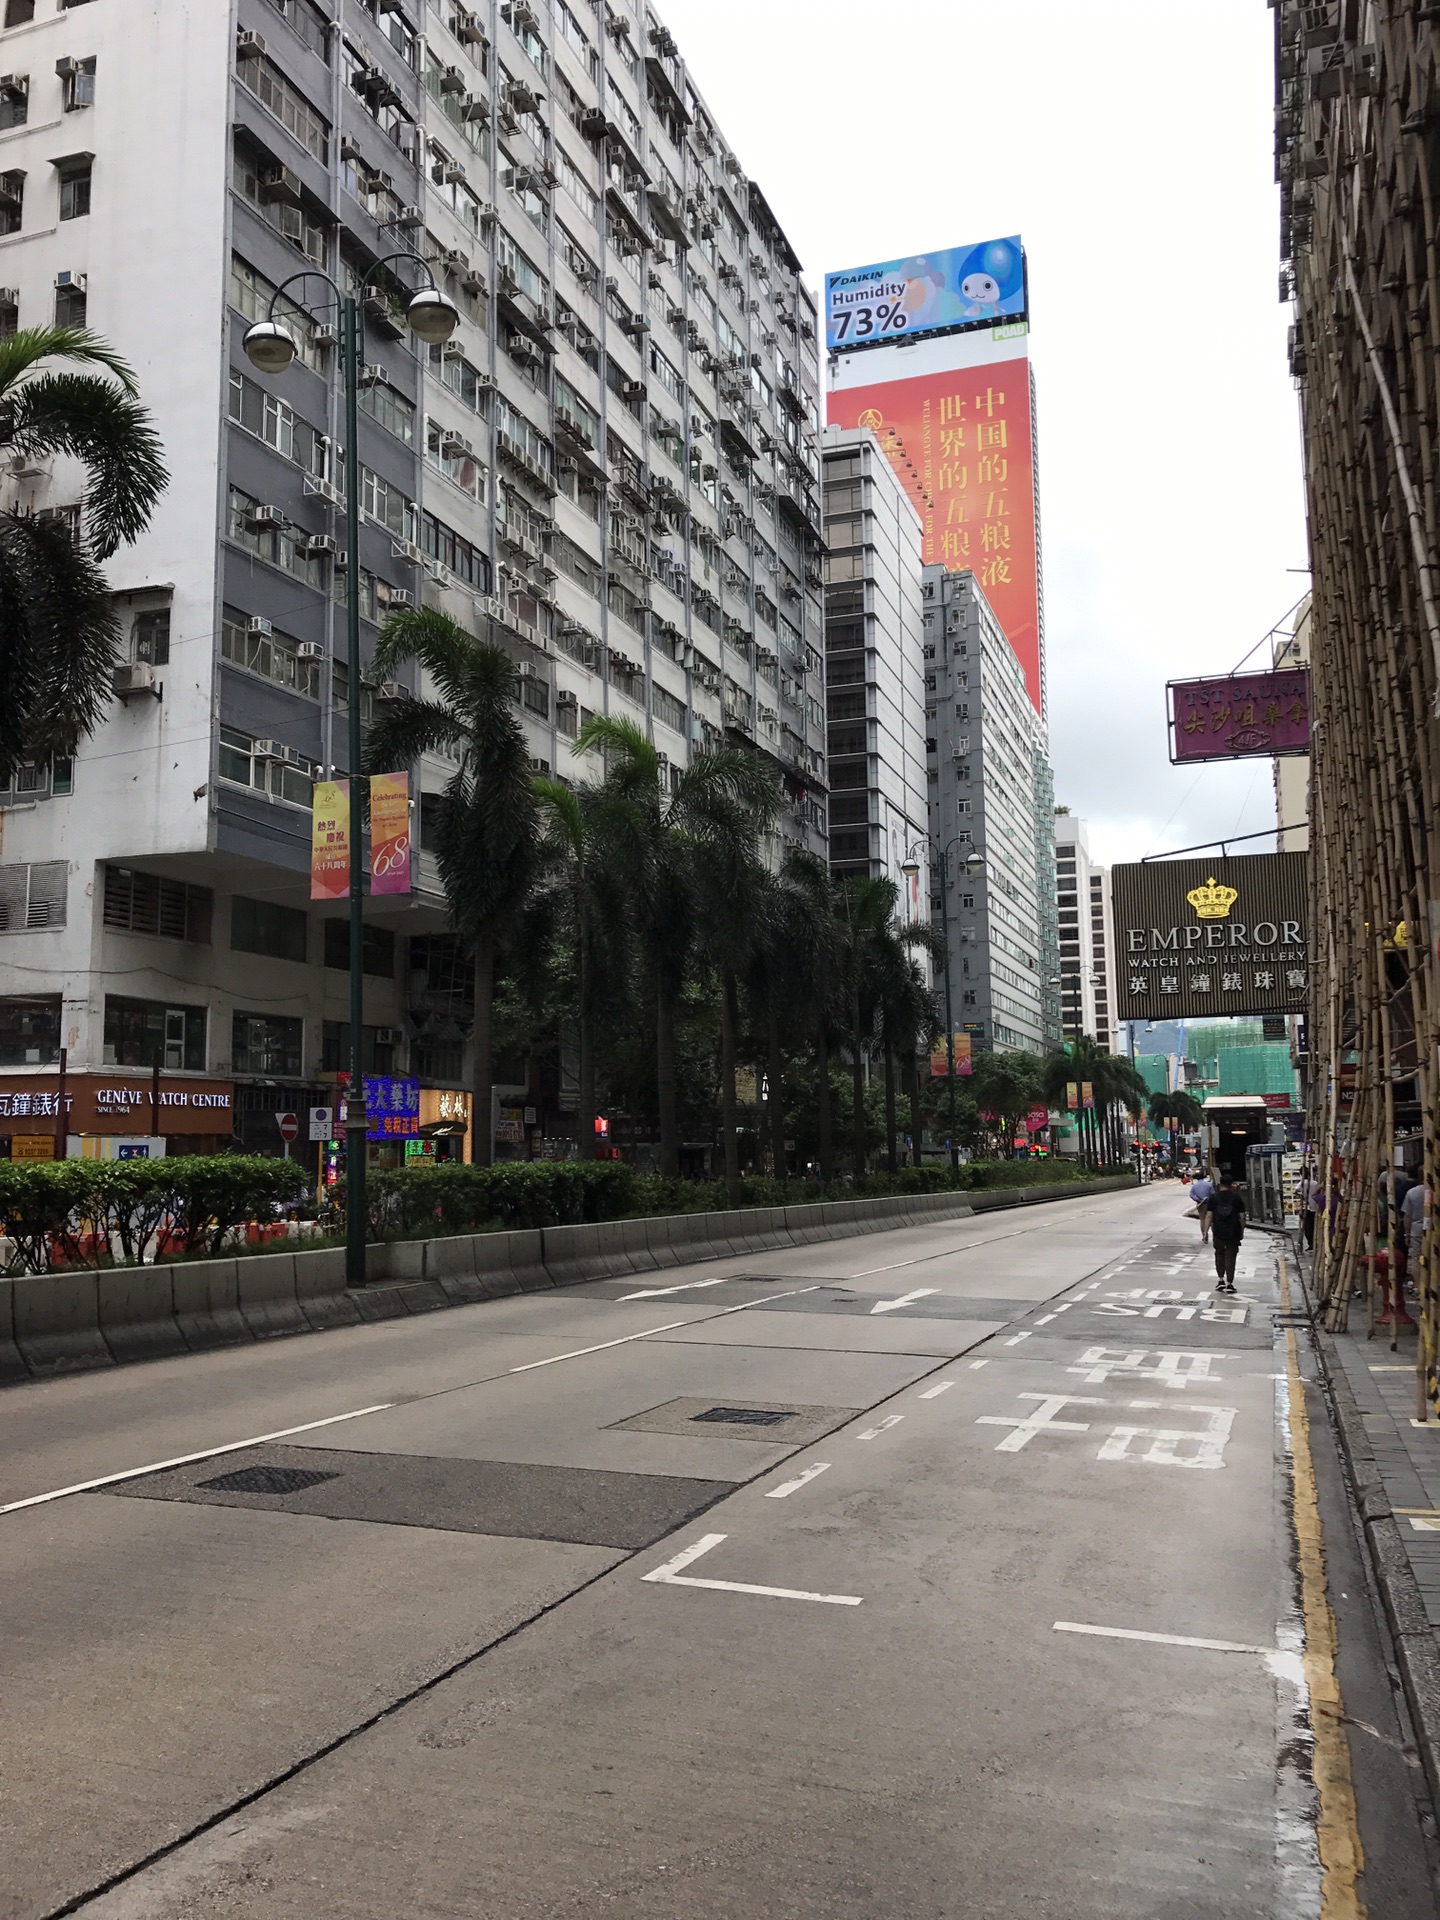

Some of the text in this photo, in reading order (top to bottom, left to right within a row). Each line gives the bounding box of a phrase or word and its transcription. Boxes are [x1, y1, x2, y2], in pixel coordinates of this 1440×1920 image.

[841, 271, 883, 285] DAIKIN
[833, 283, 906, 306] Humidity
[833, 302, 906, 339] 73%
[994, 324, 1026, 340] POAD
[922, 399, 931, 457] WULIANGYE
[924, 459, 932, 479] FOR
[975, 387, 1012, 587] 中国的五粮液
[925, 514, 934, 535] FOR
[926, 538, 934, 557] THE
[1184, 681, 1306, 706] TST SAUNA
[1184, 701, 1307, 735] 尖沙咀桑拿
[1239, 733, 1257, 746] 4/F
[372, 792, 407, 802] Celebrating
[373, 836, 408, 877] 68
[1126, 920, 1305, 952] EMPEROR
[1128, 951, 1307, 969] WATCH AND JEWELLERY
[1128, 969, 1308, 996] 英皇鐘錶珠寶
[97, 1087, 143, 1105] GENÈVE
[192, 1093, 231, 1108] CENTRE
[1090, 1302, 1247, 1324] BUS
[974, 1391, 1240, 1470] 巴士
